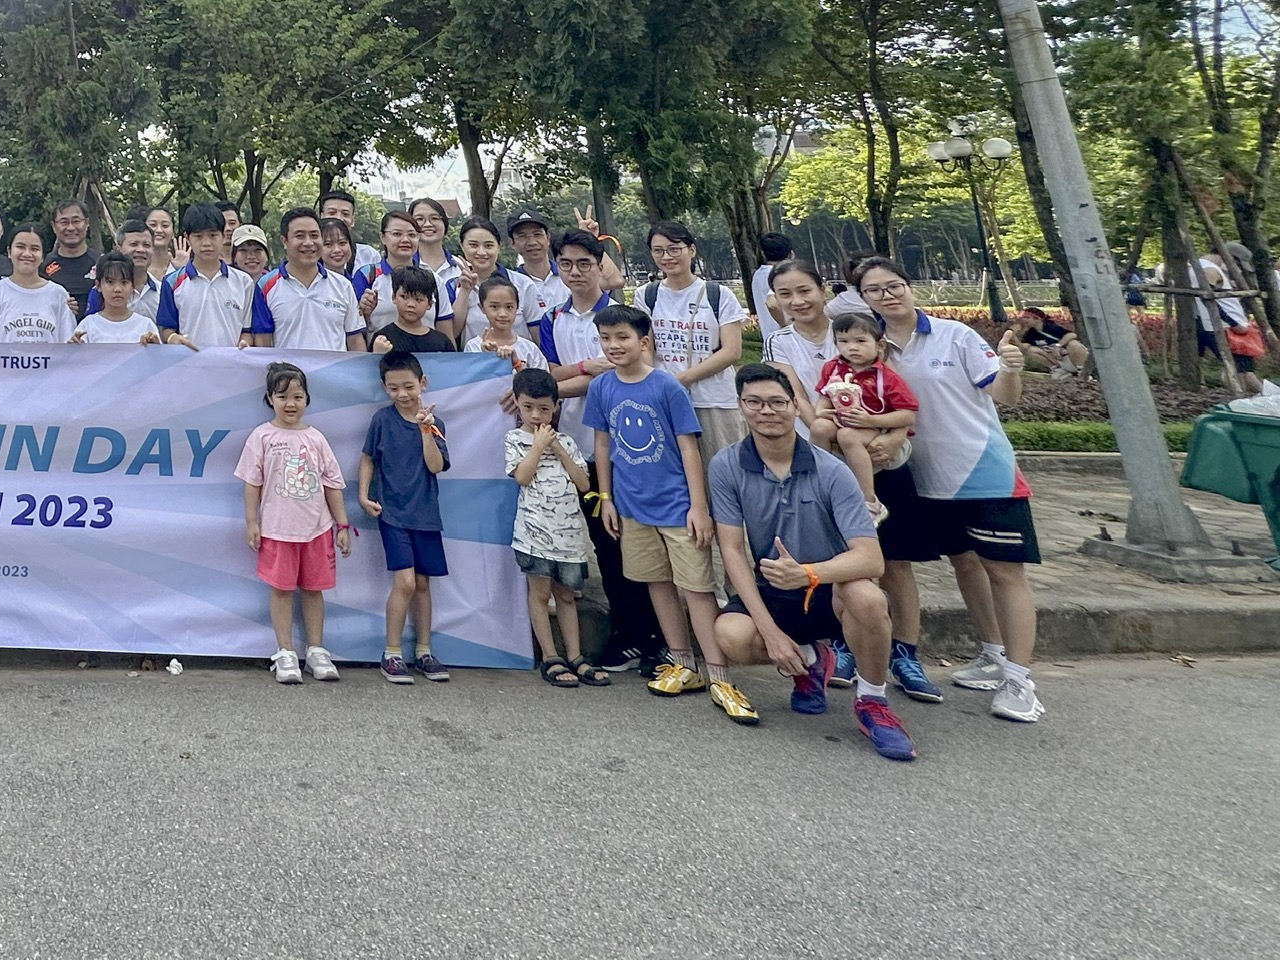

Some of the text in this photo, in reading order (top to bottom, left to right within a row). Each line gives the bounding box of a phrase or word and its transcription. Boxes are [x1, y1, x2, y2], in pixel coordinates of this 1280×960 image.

[4, 318, 56, 337] ANGEL GIRL
[16, 330, 45, 338] SOCIETY
[0, 355, 51, 370] TRUST
[72, 426, 231, 478] DAY
[11, 493, 114, 529] 2023
